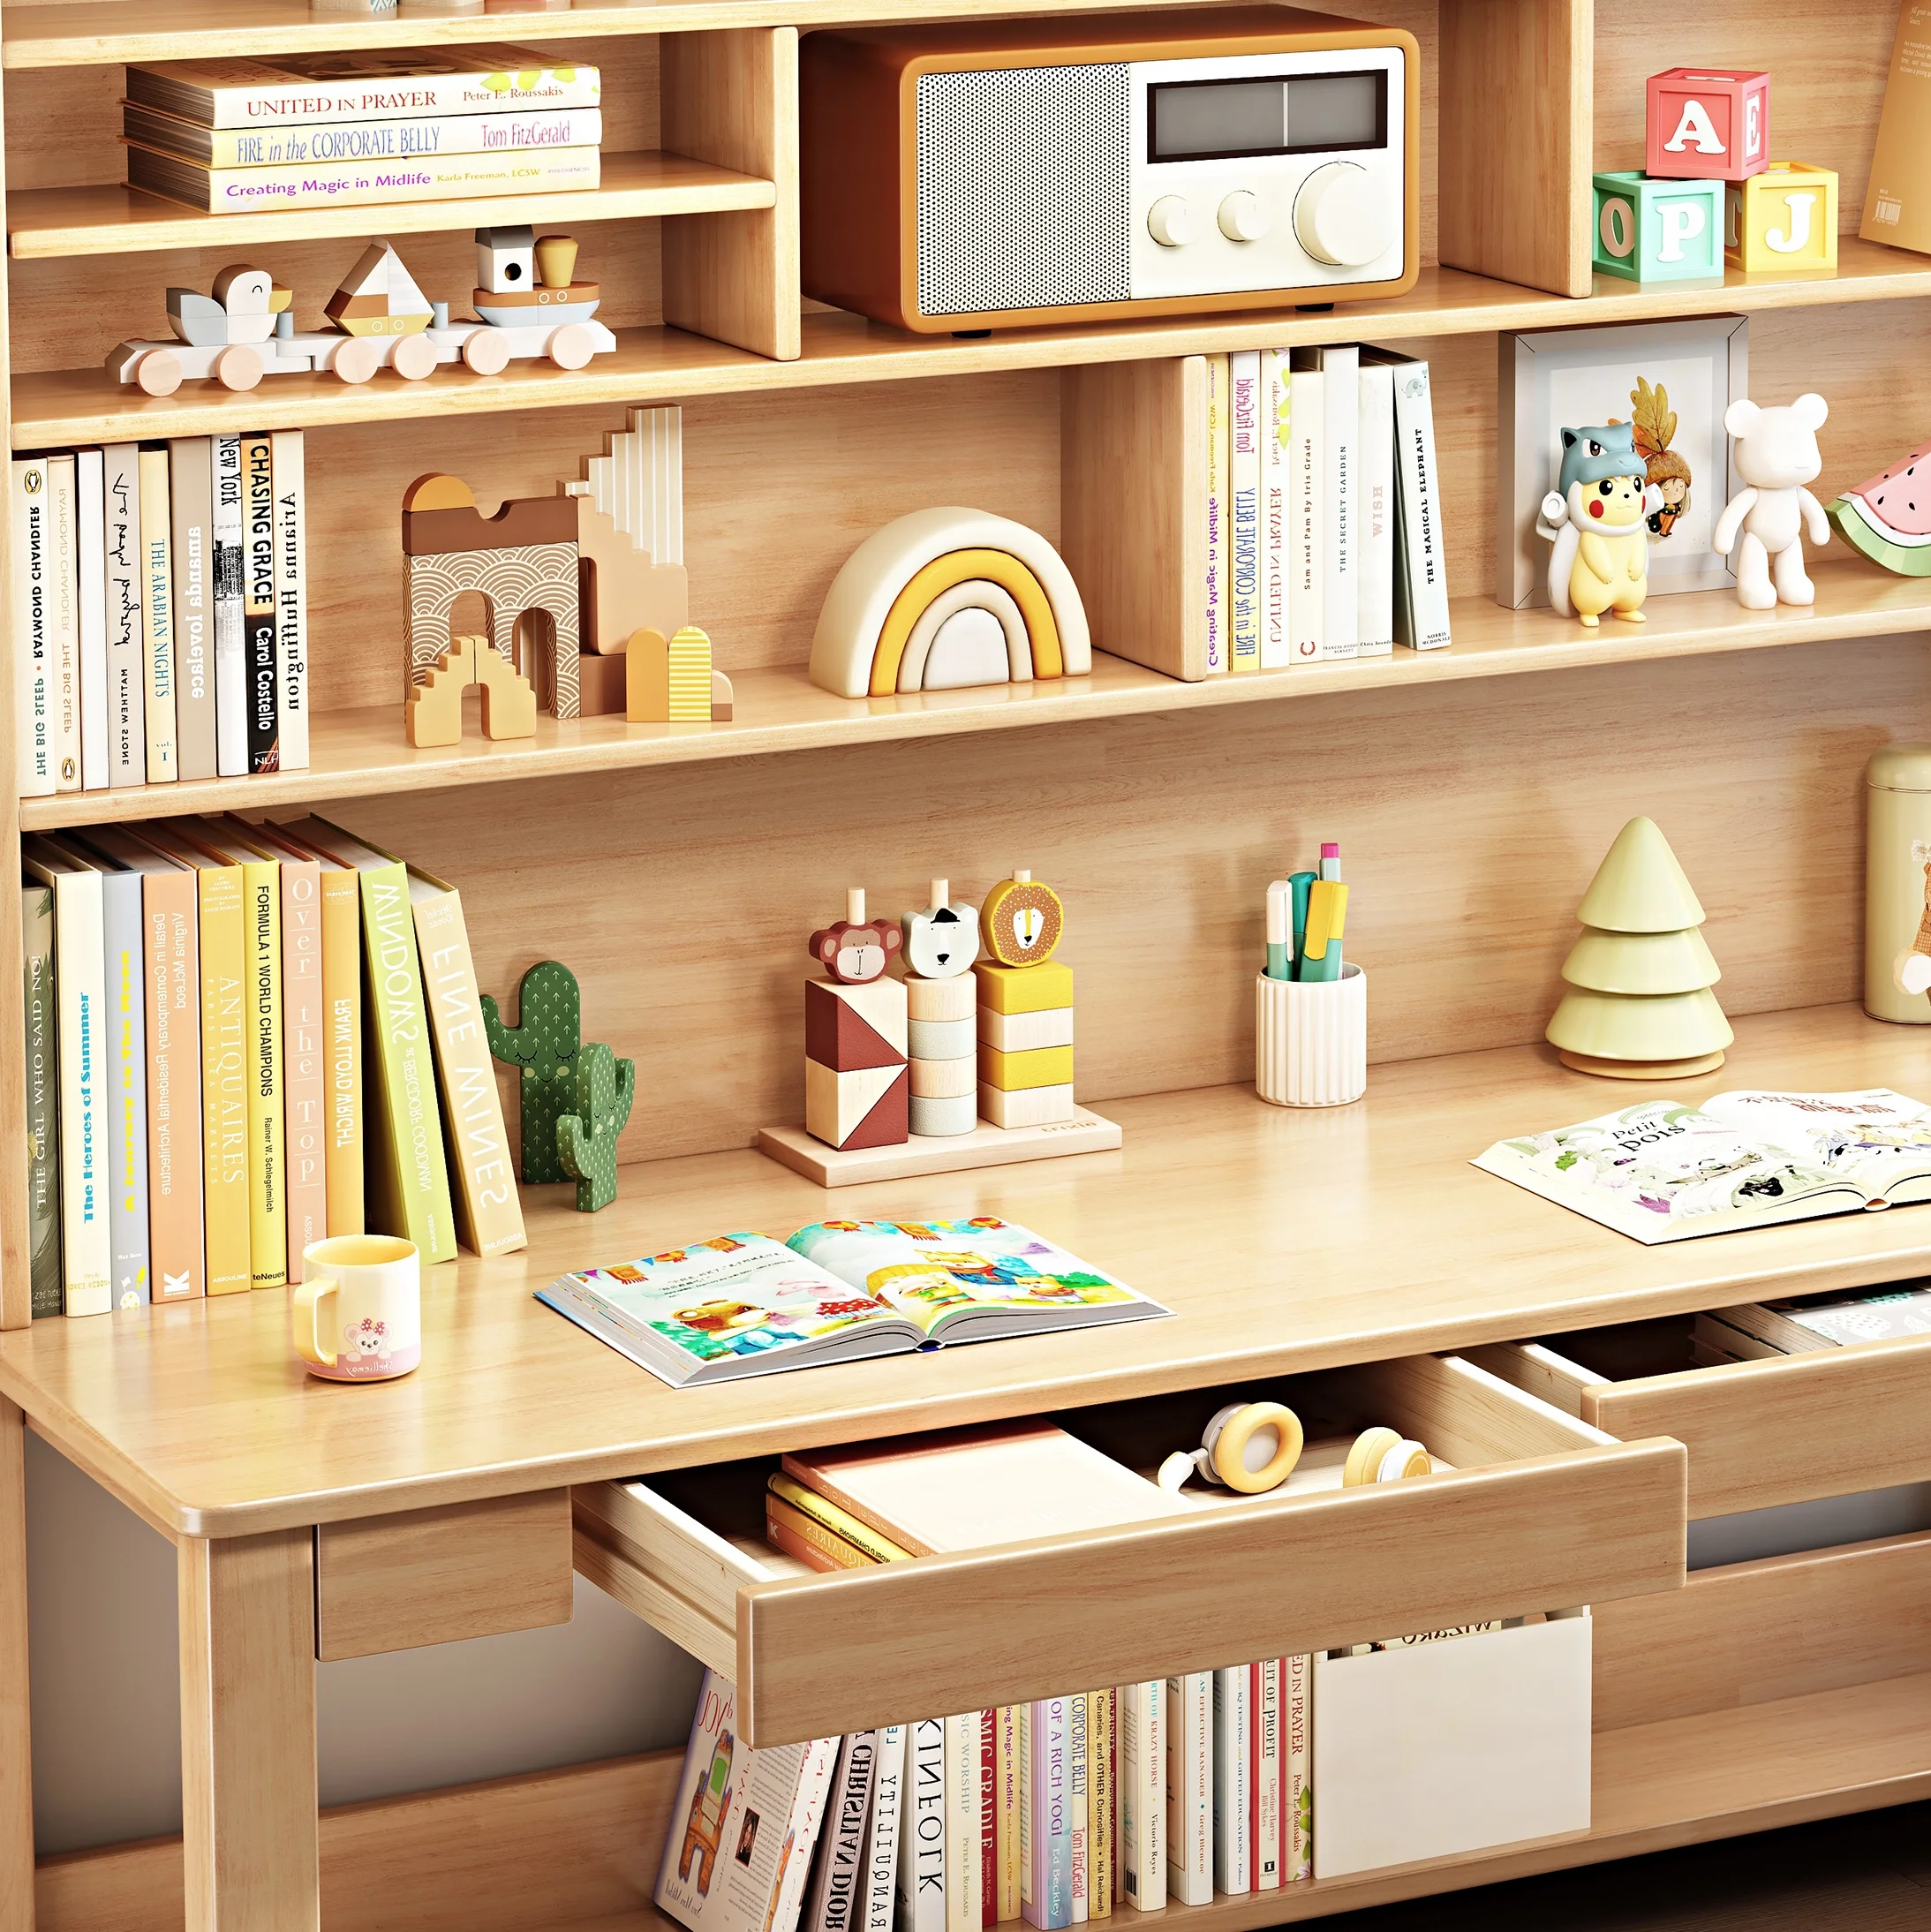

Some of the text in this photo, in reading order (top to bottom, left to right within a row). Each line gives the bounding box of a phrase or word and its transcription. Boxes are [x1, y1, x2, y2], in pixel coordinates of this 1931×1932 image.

[247, 96, 331, 116] UNITED
[337, 94, 355, 110] IN
[361, 90, 436, 109] PRAYER
[464, 89, 491, 102] Peter
[510, 86, 563, 99] Roussakis
[1663, 100, 1726, 154] A
[1746, 94, 1760, 157] E
[237, 120, 569, 163] FIRE in the CORPORATE BELLY Tom FitzGerald
[226, 168, 540, 198] Creating Magic in Midlife Karla Freeman, LCSW
[1656, 202, 1705, 263] P
[1765, 193, 1816, 253] J
[219, 438, 241, 506] New York
[1415, 429, 1427, 493] ELEPHANT
[1304, 500, 1311, 514] By
[1373, 486, 1383, 537] WISH
[1423, 499, 1432, 554] MAGICAL
[250, 446, 274, 729] CHASING GRACE Carol Costello
[151, 540, 170, 698] THE ARABIAN NIGHTS
[257, 886, 270, 950] FORMULA
[258, 965, 271, 1015] WORLD
[30, 955, 47, 1208] THE GIRL WHO SAID NO!
[120, 950, 135, 1212] A Journey to The Moon
[220, 976, 245, 1185] ANTIQUAIRES
[259, 1018, 273, 1097] CHAMPIONS
[81, 992, 94, 1224] The Heroes of Summer
[1612, 1121, 1657, 1139] Petit
[265, 1145, 272, 1156] W.
[1618, 1125, 1686, 1152] pois
[264, 1158, 273, 1212] Schlegelmilch
[213, 1273, 247, 1283] ASSOULINE
[253, 1270, 285, 1282] teNeues
[1292, 1679, 1302, 1693] IN
[1263, 1687, 1276, 1758] OF PROFIT
[1292, 1697, 1303, 1755] PRAYER
[961, 1743, 970, 1814] WORSHIP
[1004, 1726, 1014, 1809] Magic in Midlife
[1294, 1774, 1302, 1795] Peter
[1051, 1702, 1062, 1916] OF A RICH YOGI Ed Beckley
[1072, 1697, 1086, 1898] CORPORATE BELLY Tom FitzGerald
[1294, 1811, 1302, 1852] Roussakis
